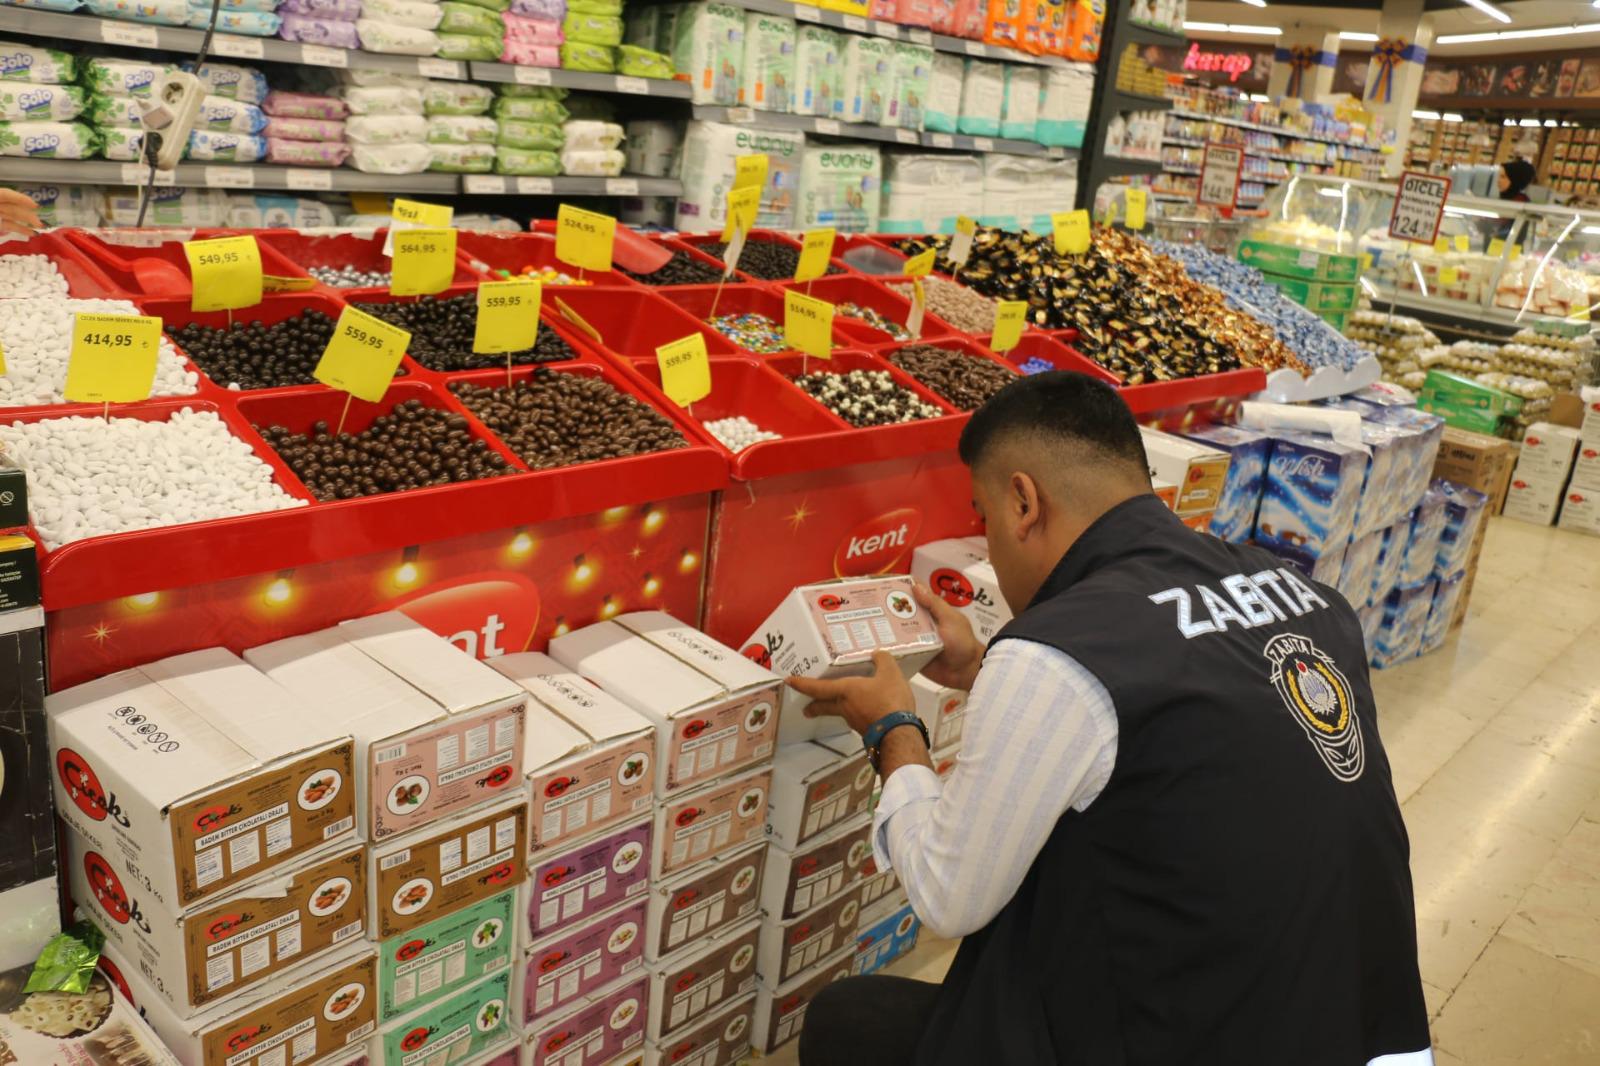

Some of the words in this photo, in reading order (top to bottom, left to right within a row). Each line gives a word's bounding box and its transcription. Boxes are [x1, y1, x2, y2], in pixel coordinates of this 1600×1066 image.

[0, 53, 33, 70] Solo
[1184, 43, 1252, 82] kasap
[125, 70, 154, 88] Solo
[211, 70, 240, 86] Solo
[18, 89, 52, 109] Solo
[207, 105, 237, 121] Solo
[25, 134, 59, 151] Solo
[211, 135, 240, 151] Solo
[820, 150, 874, 170] evony
[486, 296, 521, 308] 559,95
[83, 333, 132, 347] 414,95
[344, 324, 384, 349] 559,95
[846, 523, 909, 560] kent
[1147, 567, 1330, 639] ZABITA
[440, 614, 505, 658] nt
[1268, 637, 1309, 664] ZABITA
[144, 876, 152, 892] 3
